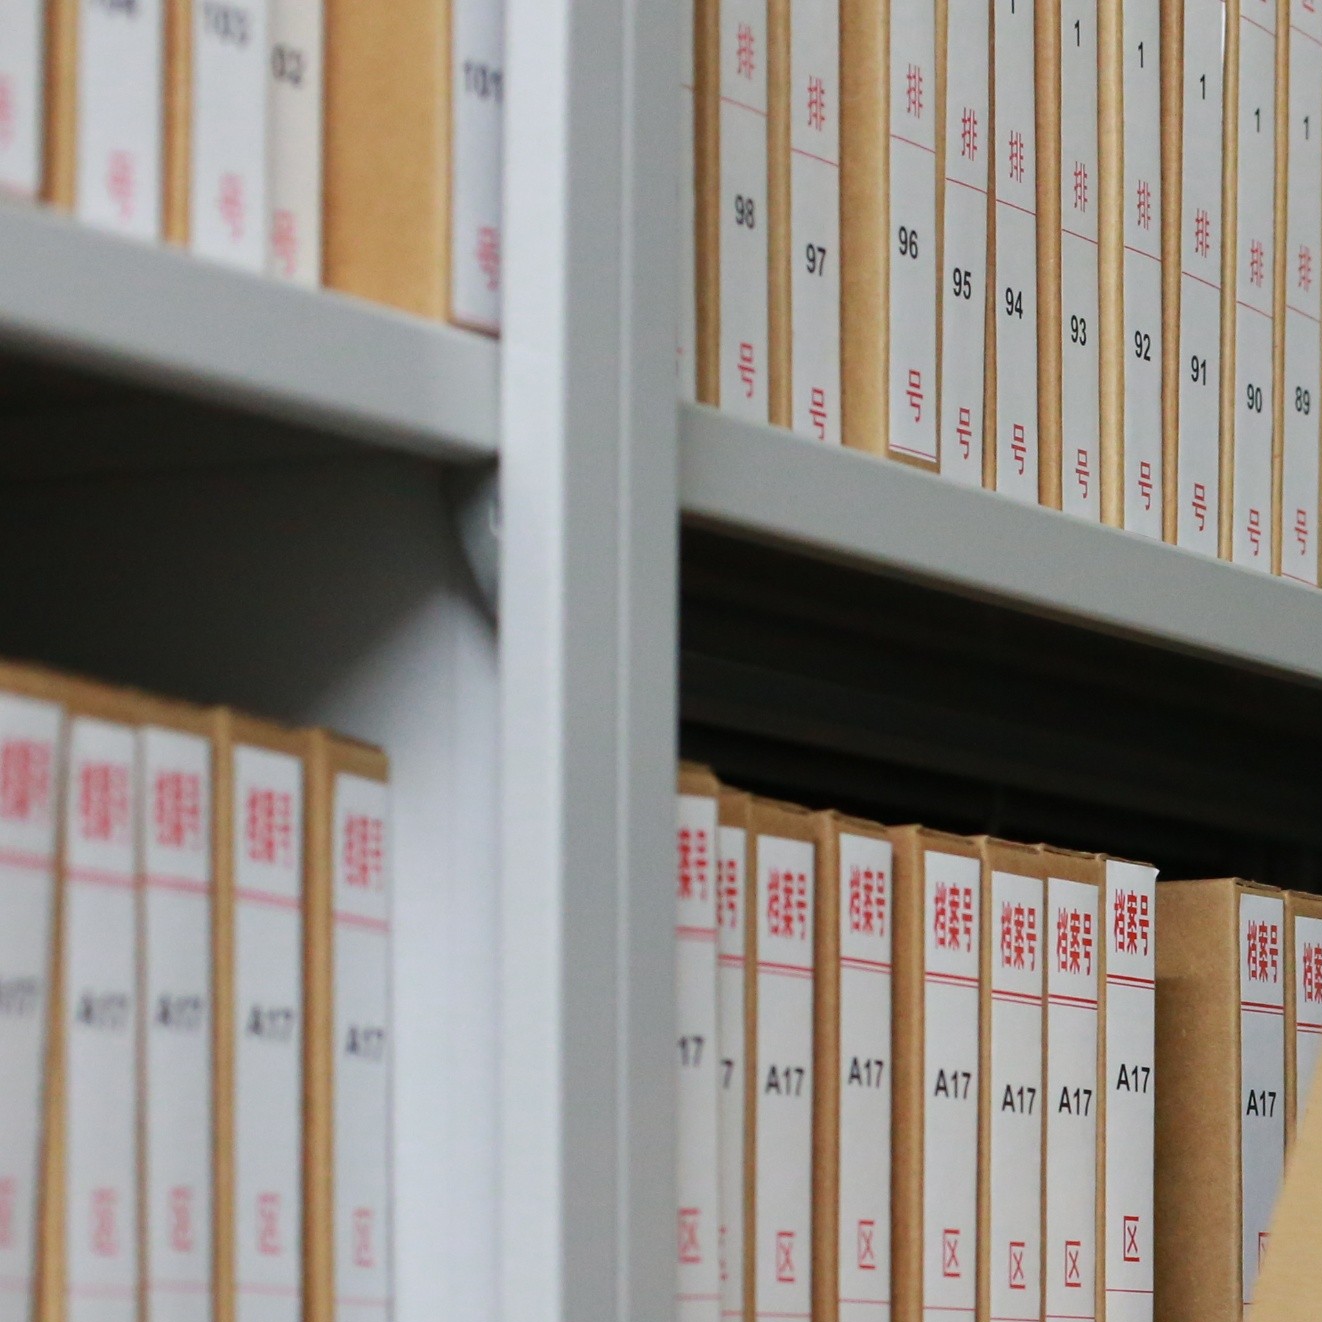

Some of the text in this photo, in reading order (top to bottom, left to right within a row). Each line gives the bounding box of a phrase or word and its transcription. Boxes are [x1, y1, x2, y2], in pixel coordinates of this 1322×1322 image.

[1073, 20, 1081, 46] 1
[1137, 42, 1145, 68] 1
[808, 75, 825, 131] 排
[907, 64, 922, 118] 排
[1199, 74, 1206, 99] 1
[961, 108, 977, 161] 排
[1254, 108, 1260, 133] 1
[1303, 116, 1310, 140] 1
[1009, 131, 1024, 183] 排
[1074, 161, 1087, 212] 排
[1137, 180, 1151, 229] 排
[735, 195, 754, 229] 98
[1195, 208, 1210, 258] 排
[806, 244, 826, 276] 97
[898, 226, 918, 259] 96
[1250, 239, 1263, 287] 排
[952, 267, 972, 300] 95
[1298, 245, 1311, 292] 排
[1005, 288, 1023, 319] 94
[1070, 316, 1087, 346] 93
[1134, 331, 1151, 361] 92
[737, 343, 754, 398] 号
[1191, 355, 1206, 385] 91
[809, 388, 827, 440] 号
[906, 370, 923, 422] 号
[1247, 384, 1262, 414] 90
[1295, 387, 1310, 415] 89
[957, 408, 972, 460] 号
[1011, 424, 1026, 475] 号
[1076, 450, 1089, 499] 号
[1138, 462, 1152, 510] 号
[1192, 484, 1206, 531] 号
[1247, 509, 1261, 556] 号
[1295, 510, 1308, 556] 号
[767, 867, 808, 940] 档案号
[850, 865, 886, 937] 档案号
[934, 881, 974, 952] 档案号
[1114, 889, 1150, 957] 档案号
[1000, 901, 1037, 973] 档案号
[1057, 907, 1093, 975] 档案号
[1247, 920, 1279, 983] 档案号
[766, 1065, 804, 1096] A17
[849, 1057, 884, 1089] A17
[935, 1069, 971, 1099] A17
[1117, 1063, 1151, 1093] A17
[1002, 1084, 1037, 1116] A17
[1058, 1086, 1092, 1116] A17
[1247, 1089, 1276, 1117] A17
[776, 1231, 795, 1282] 区
[858, 1220, 876, 1270] 区
[943, 1229, 961, 1277] 区
[1123, 1216, 1140, 1262] 区
[1009, 1242, 1025, 1289] 区
[1065, 1240, 1081, 1287] 区
